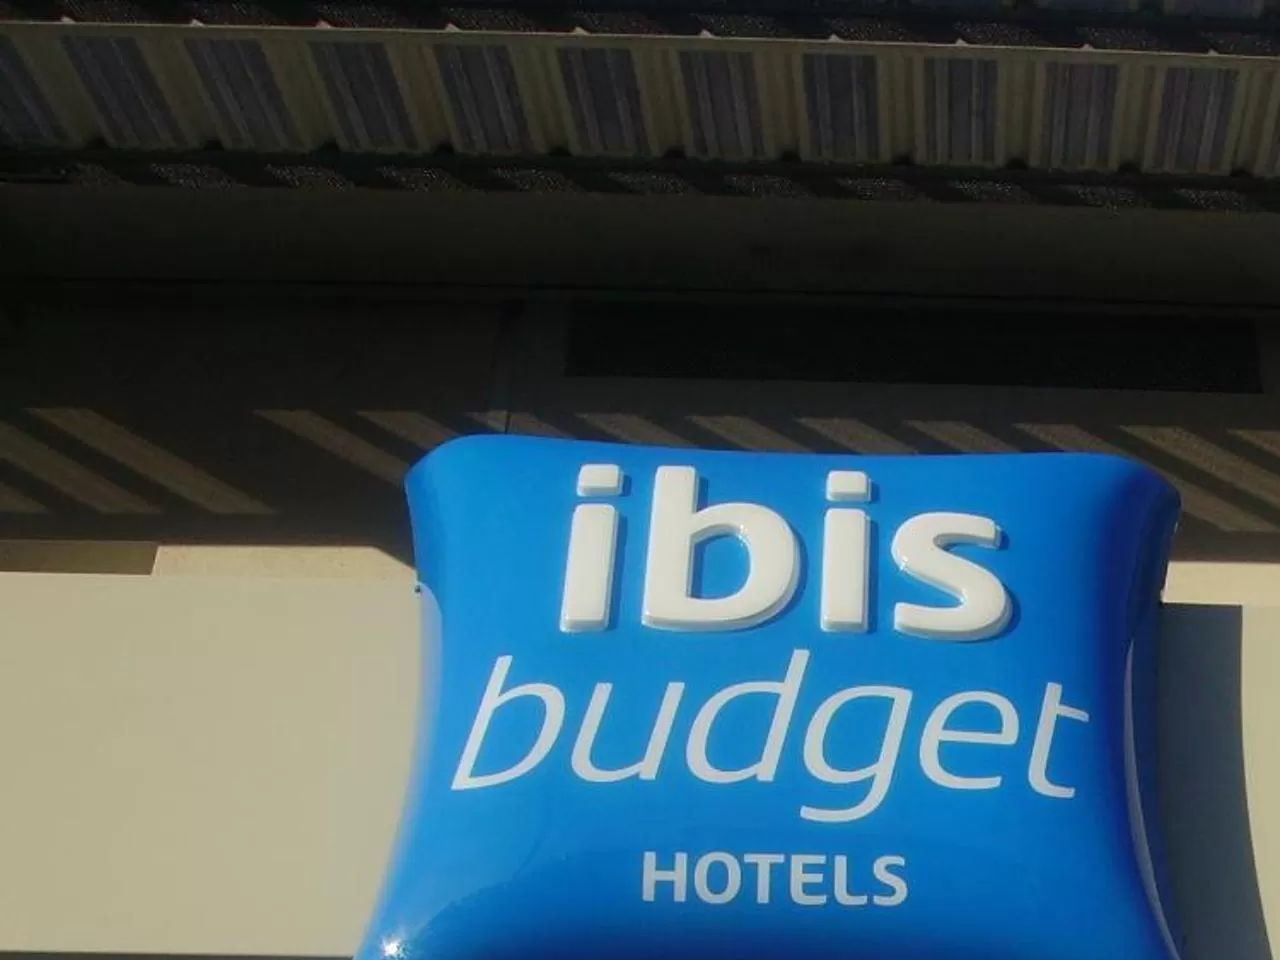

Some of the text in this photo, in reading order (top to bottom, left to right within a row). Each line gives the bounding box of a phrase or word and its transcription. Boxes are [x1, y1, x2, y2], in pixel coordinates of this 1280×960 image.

[559, 463, 1013, 640] ibis
[451, 649, 1089, 823] budget
[642, 850, 909, 907] HOTELS
